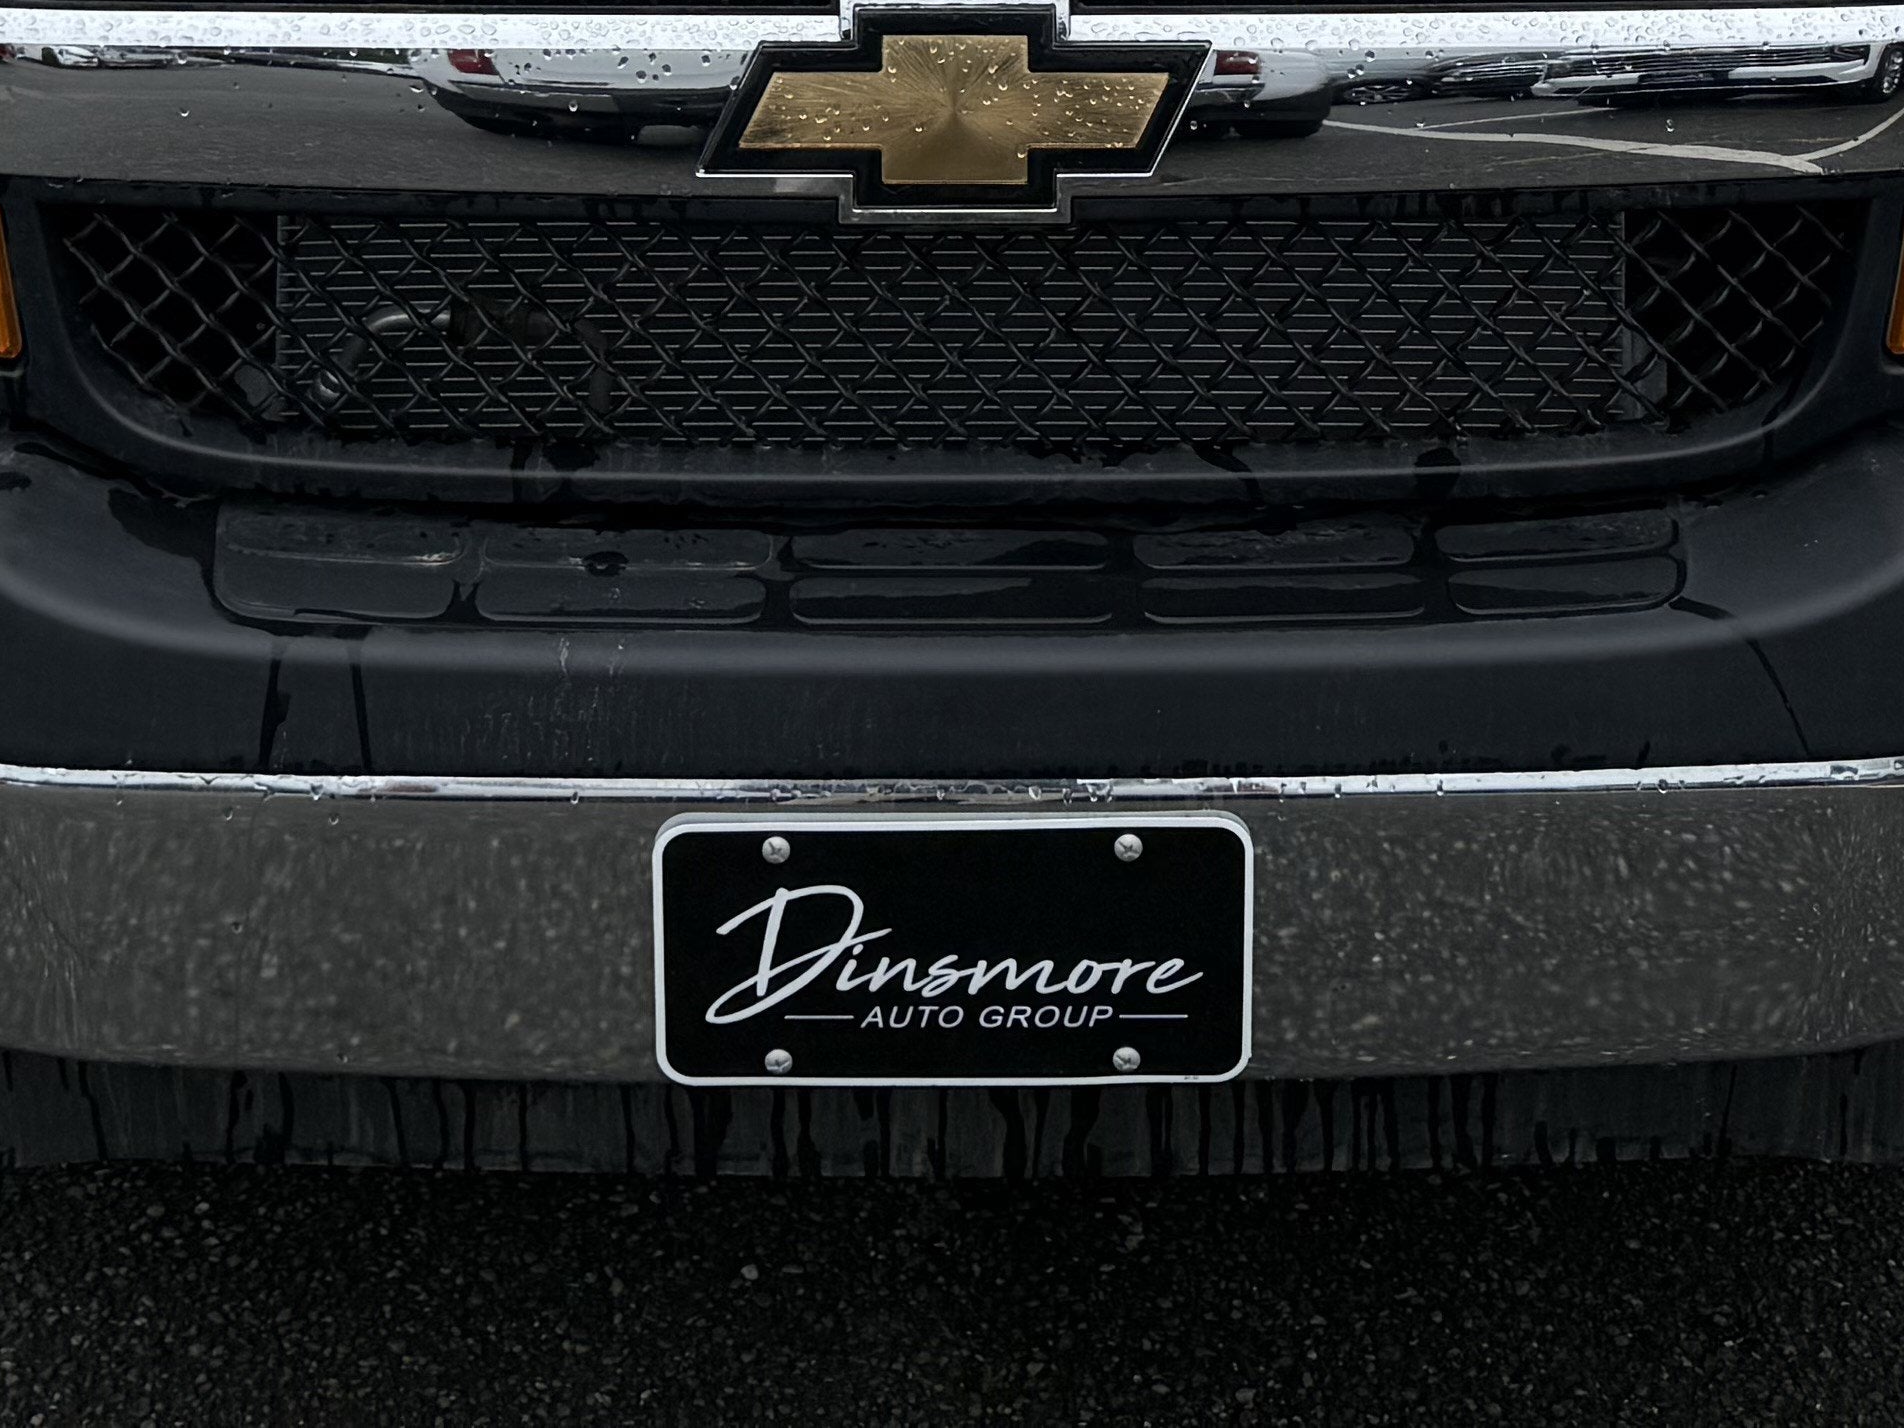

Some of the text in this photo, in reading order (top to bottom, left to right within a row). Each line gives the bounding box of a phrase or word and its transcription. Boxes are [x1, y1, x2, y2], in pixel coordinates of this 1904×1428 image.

[704, 884, 1204, 1025] Dinsmore
[860, 1004, 1114, 1029] AUTO GROUP
